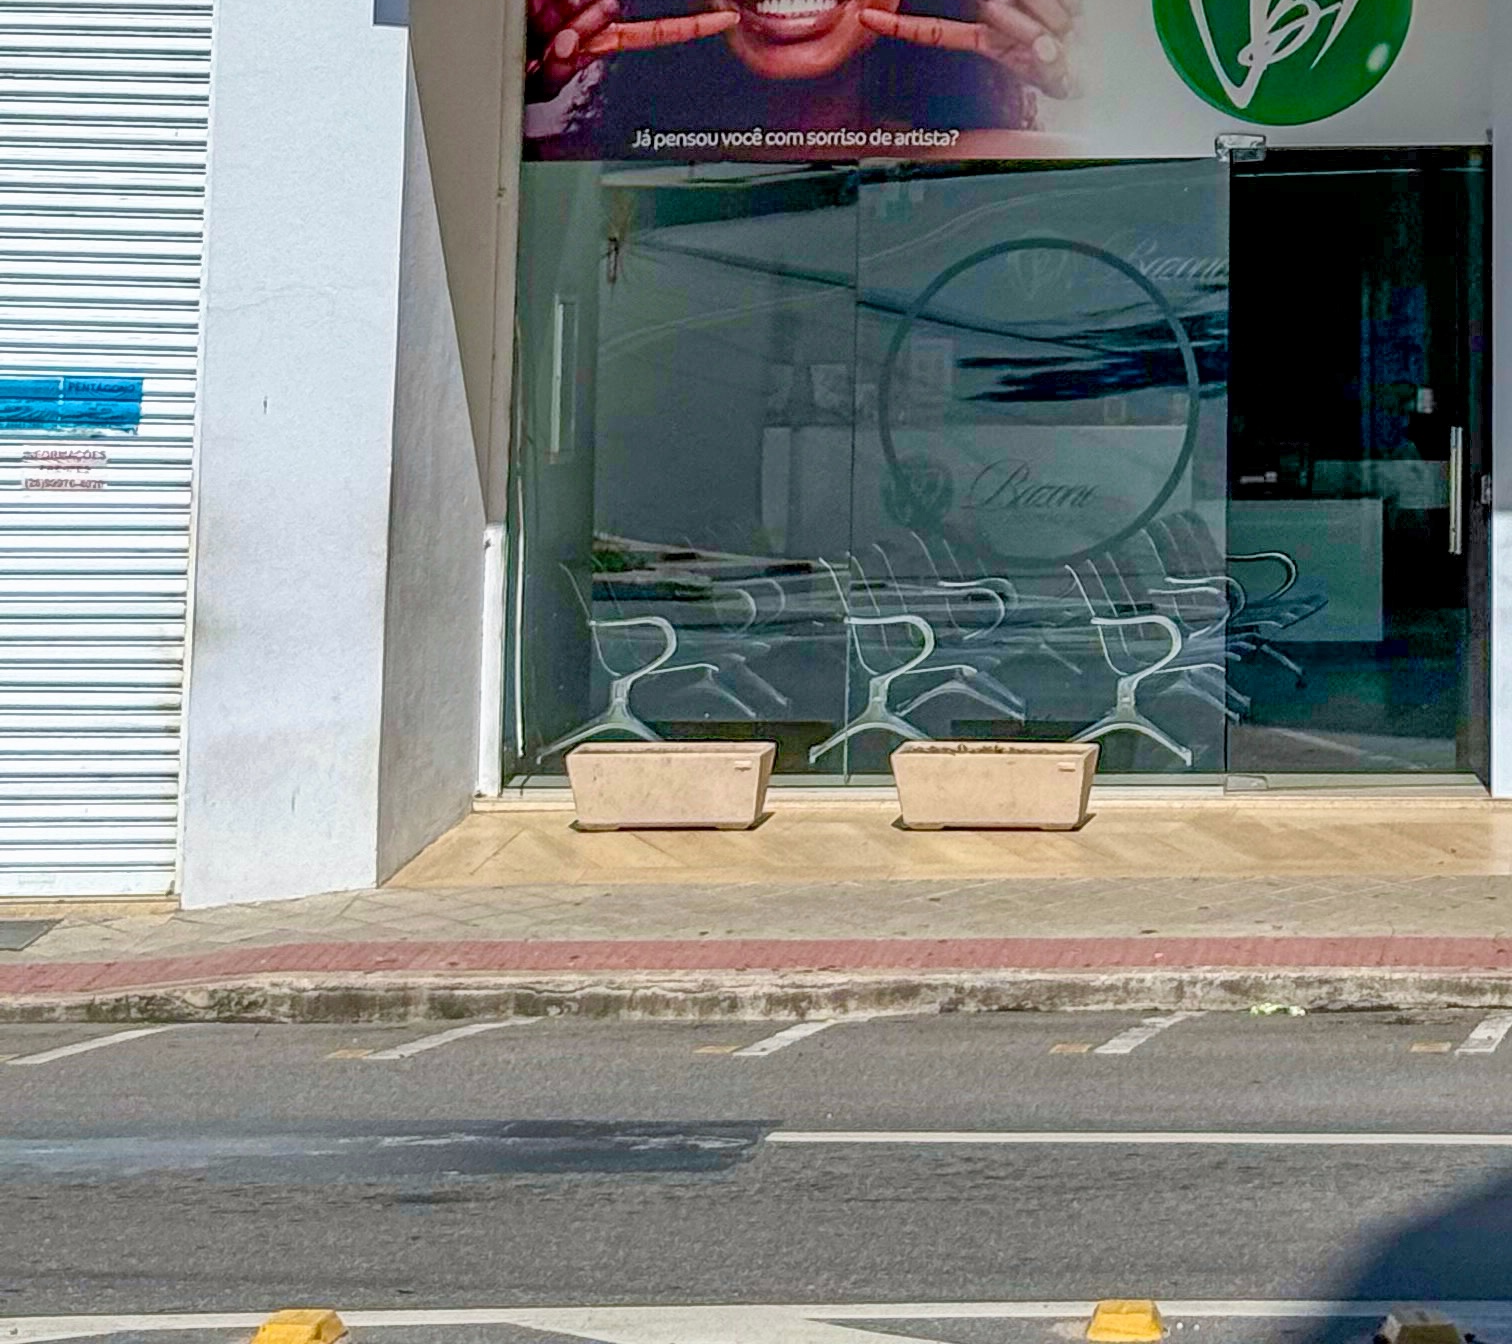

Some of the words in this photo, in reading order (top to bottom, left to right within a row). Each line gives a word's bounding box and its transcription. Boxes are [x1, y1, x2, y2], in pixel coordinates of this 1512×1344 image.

[632, 130, 650, 148] Já
[653, 131, 718, 150] pensou
[721, 127, 762, 146] você
[765, 131, 803, 146] com
[806, 129, 867, 146] sorriso
[869, 128, 891, 145] de
[894, 129, 960, 146] artista?
